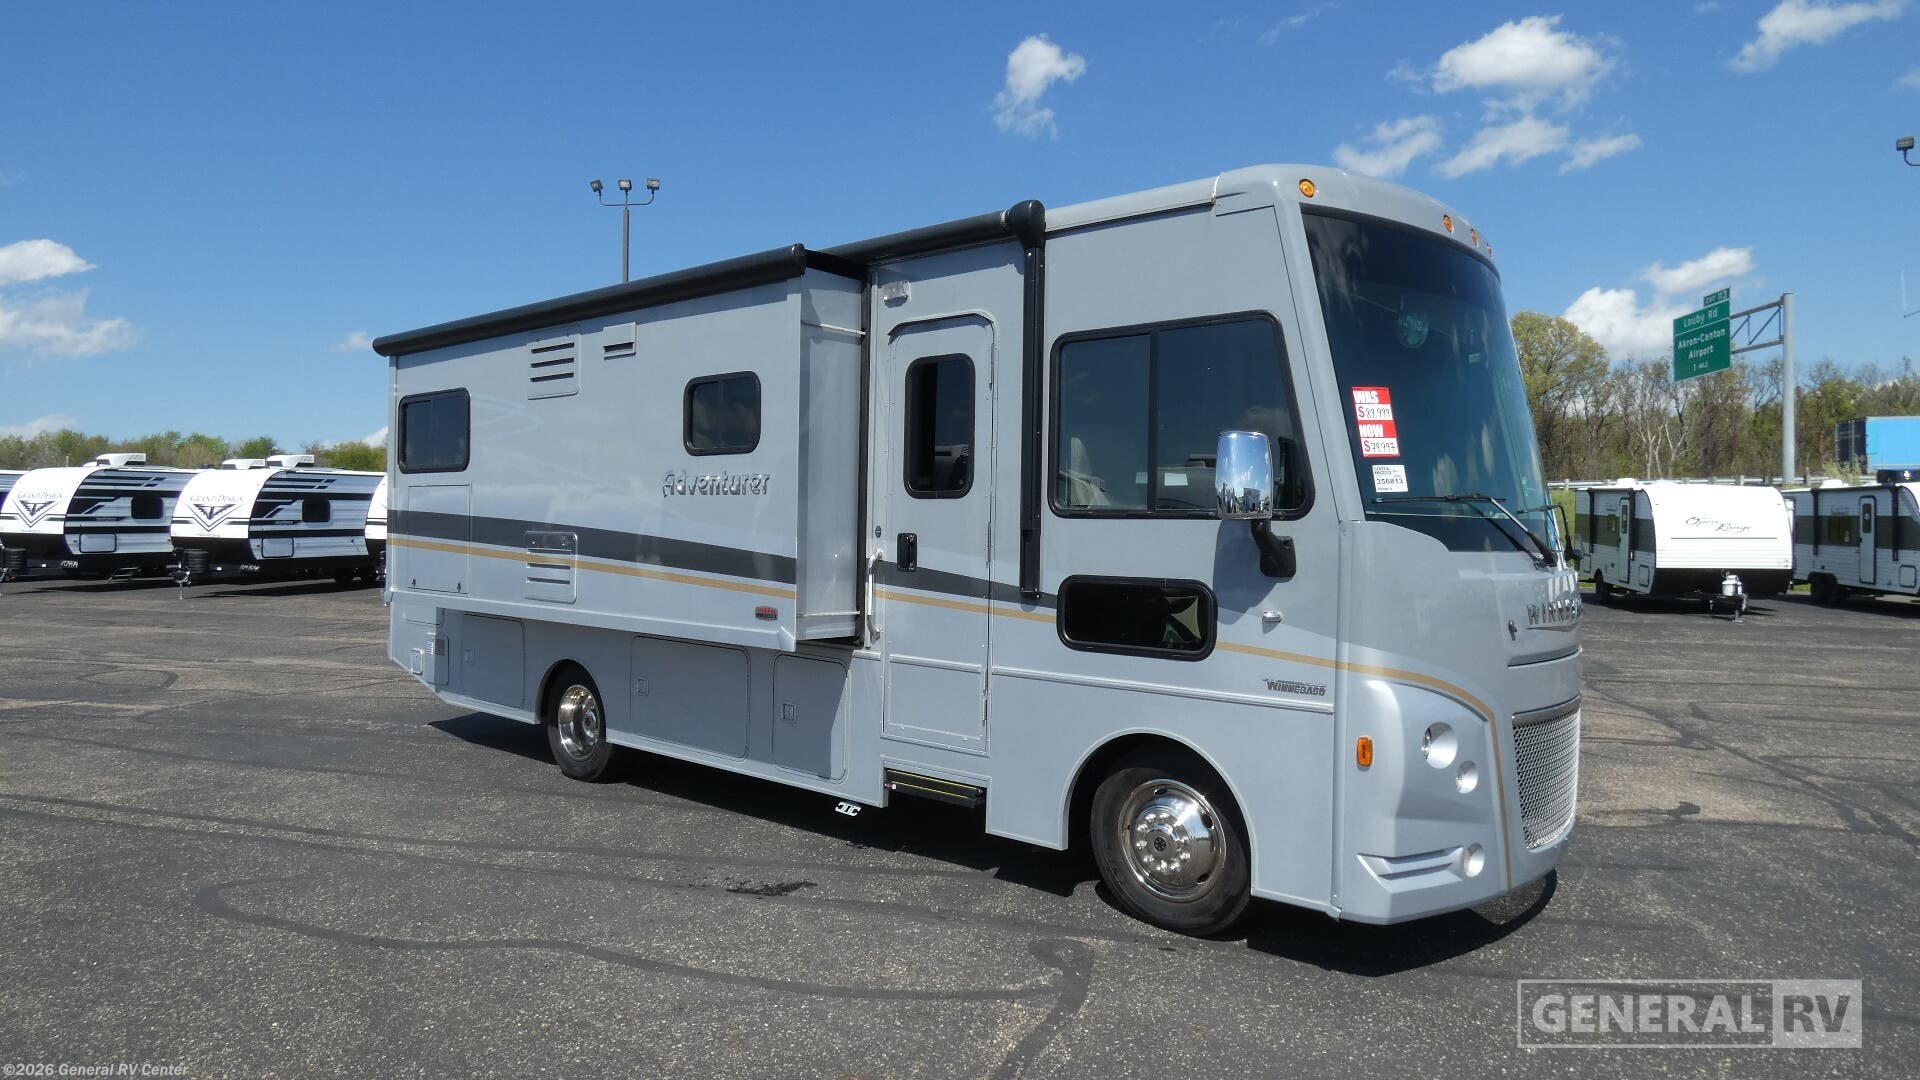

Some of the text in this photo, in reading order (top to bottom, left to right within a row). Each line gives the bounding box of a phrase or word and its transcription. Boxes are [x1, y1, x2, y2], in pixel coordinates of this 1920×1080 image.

[1705, 290, 1727, 304] EXIT 113
[1683, 308, 1718, 328] Lauby Rd
[1678, 328, 1726, 349] Akron-Canton
[1688, 345, 1714, 360] Airport
[1353, 391, 1379, 404] WAS
[1358, 424, 1384, 437] NOW
[662, 470, 770, 498] Adventurer
[1264, 680, 1326, 696] WINNEBAGO
